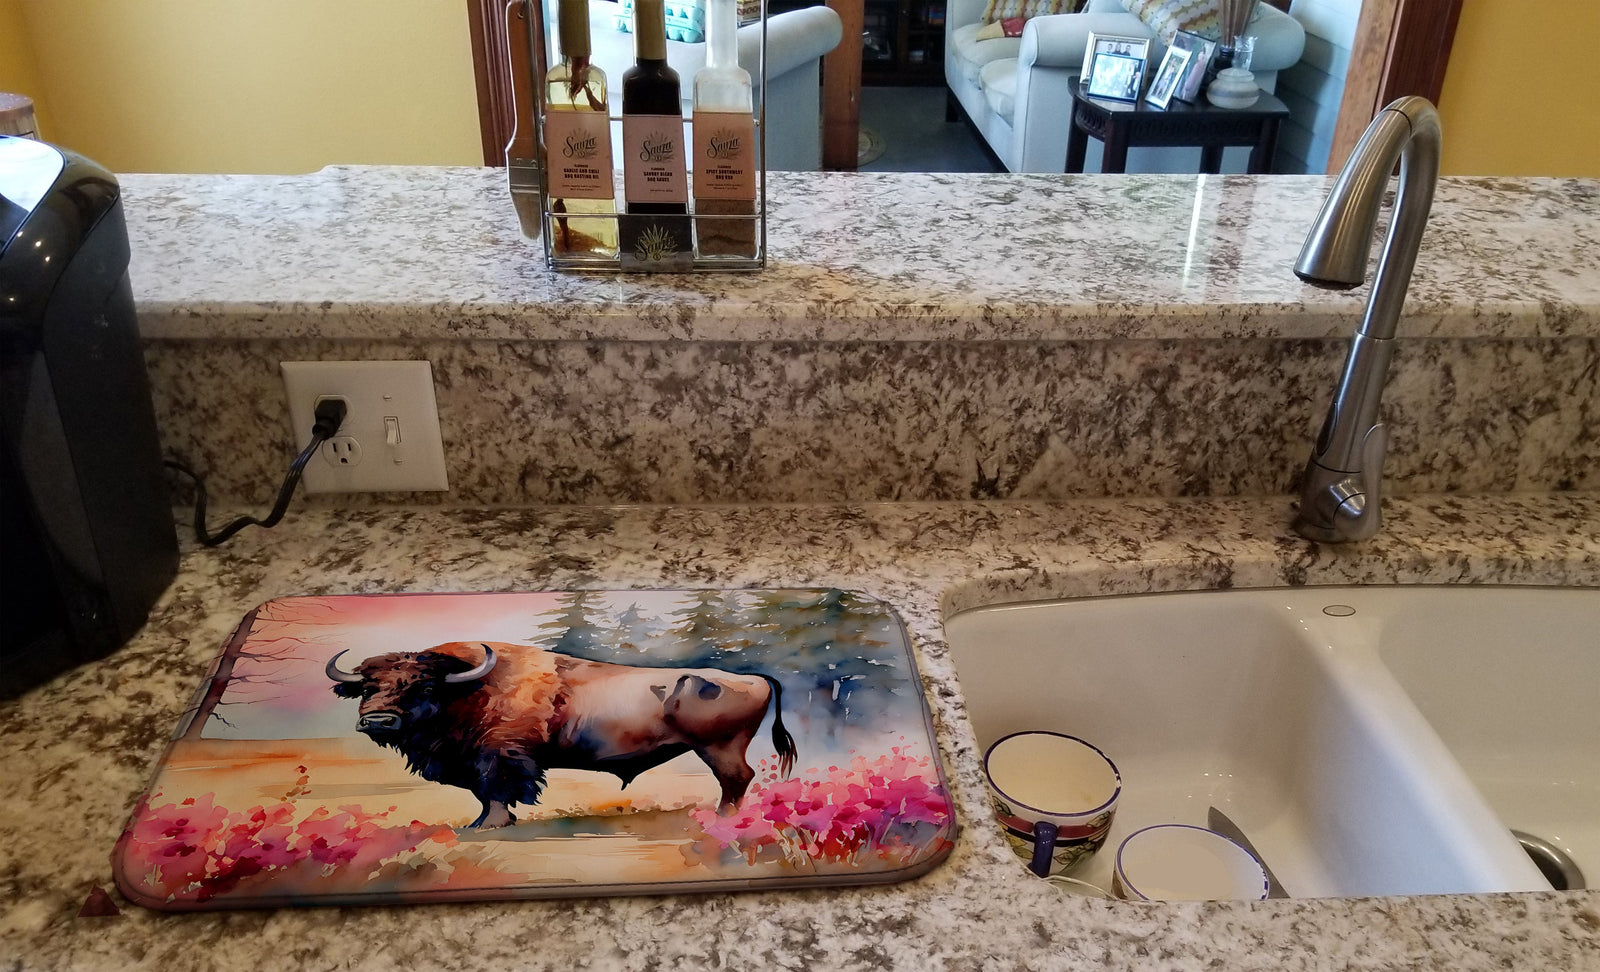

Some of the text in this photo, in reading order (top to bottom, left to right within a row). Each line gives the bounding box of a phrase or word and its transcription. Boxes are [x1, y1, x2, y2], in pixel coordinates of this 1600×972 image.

[562, 135, 597, 158] Sauza
[640, 140, 673, 162] Sauza
[707, 136, 740, 159] Sauza
